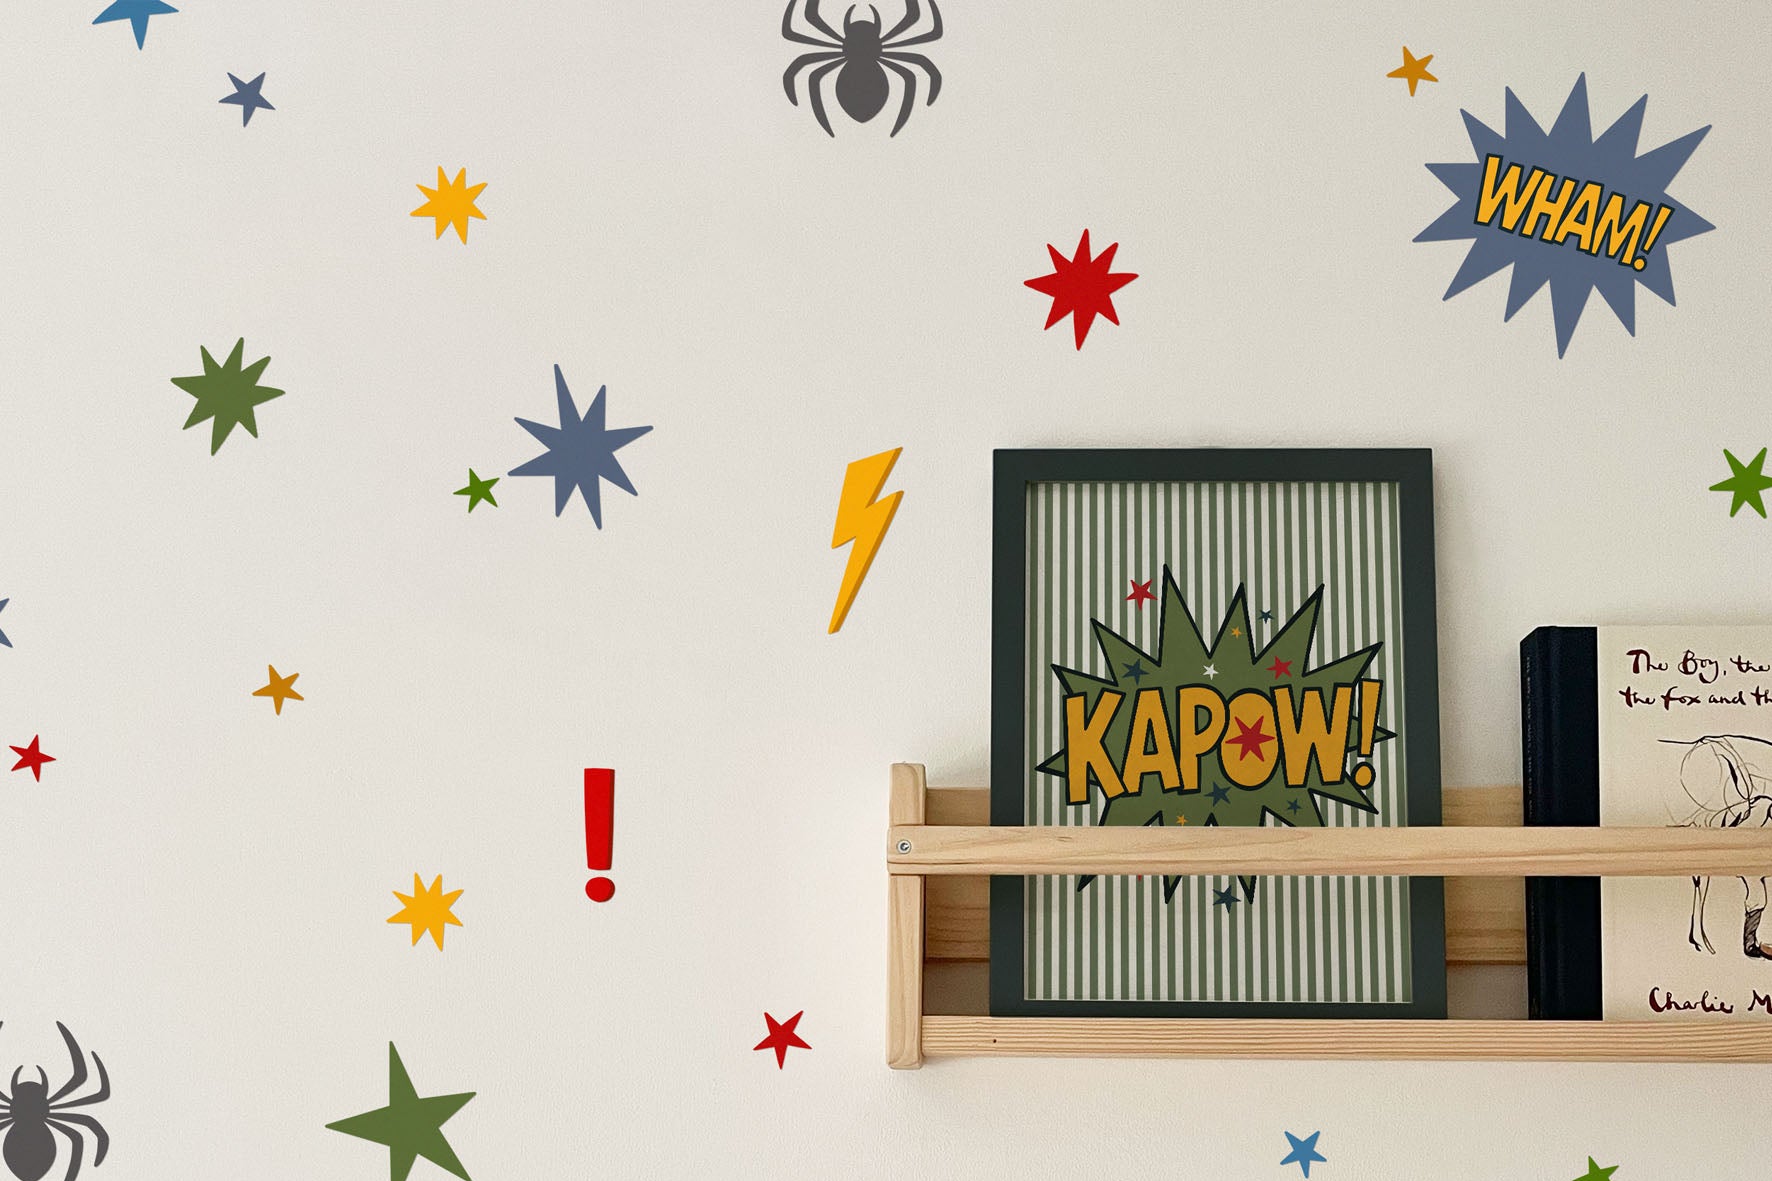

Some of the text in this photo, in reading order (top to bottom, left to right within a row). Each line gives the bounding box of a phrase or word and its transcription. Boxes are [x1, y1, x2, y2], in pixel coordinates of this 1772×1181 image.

[1474, 153, 1675, 272] WHAM!
[1626, 649, 1771, 684] The Boy, the
[1619, 686, 1656, 708] the
[1661, 686, 1701, 711] fox
[1708, 690, 1747, 706] and
[1063, 679, 1383, 806] KAPOW!
[1649, 987, 1734, 1014] Charlie
